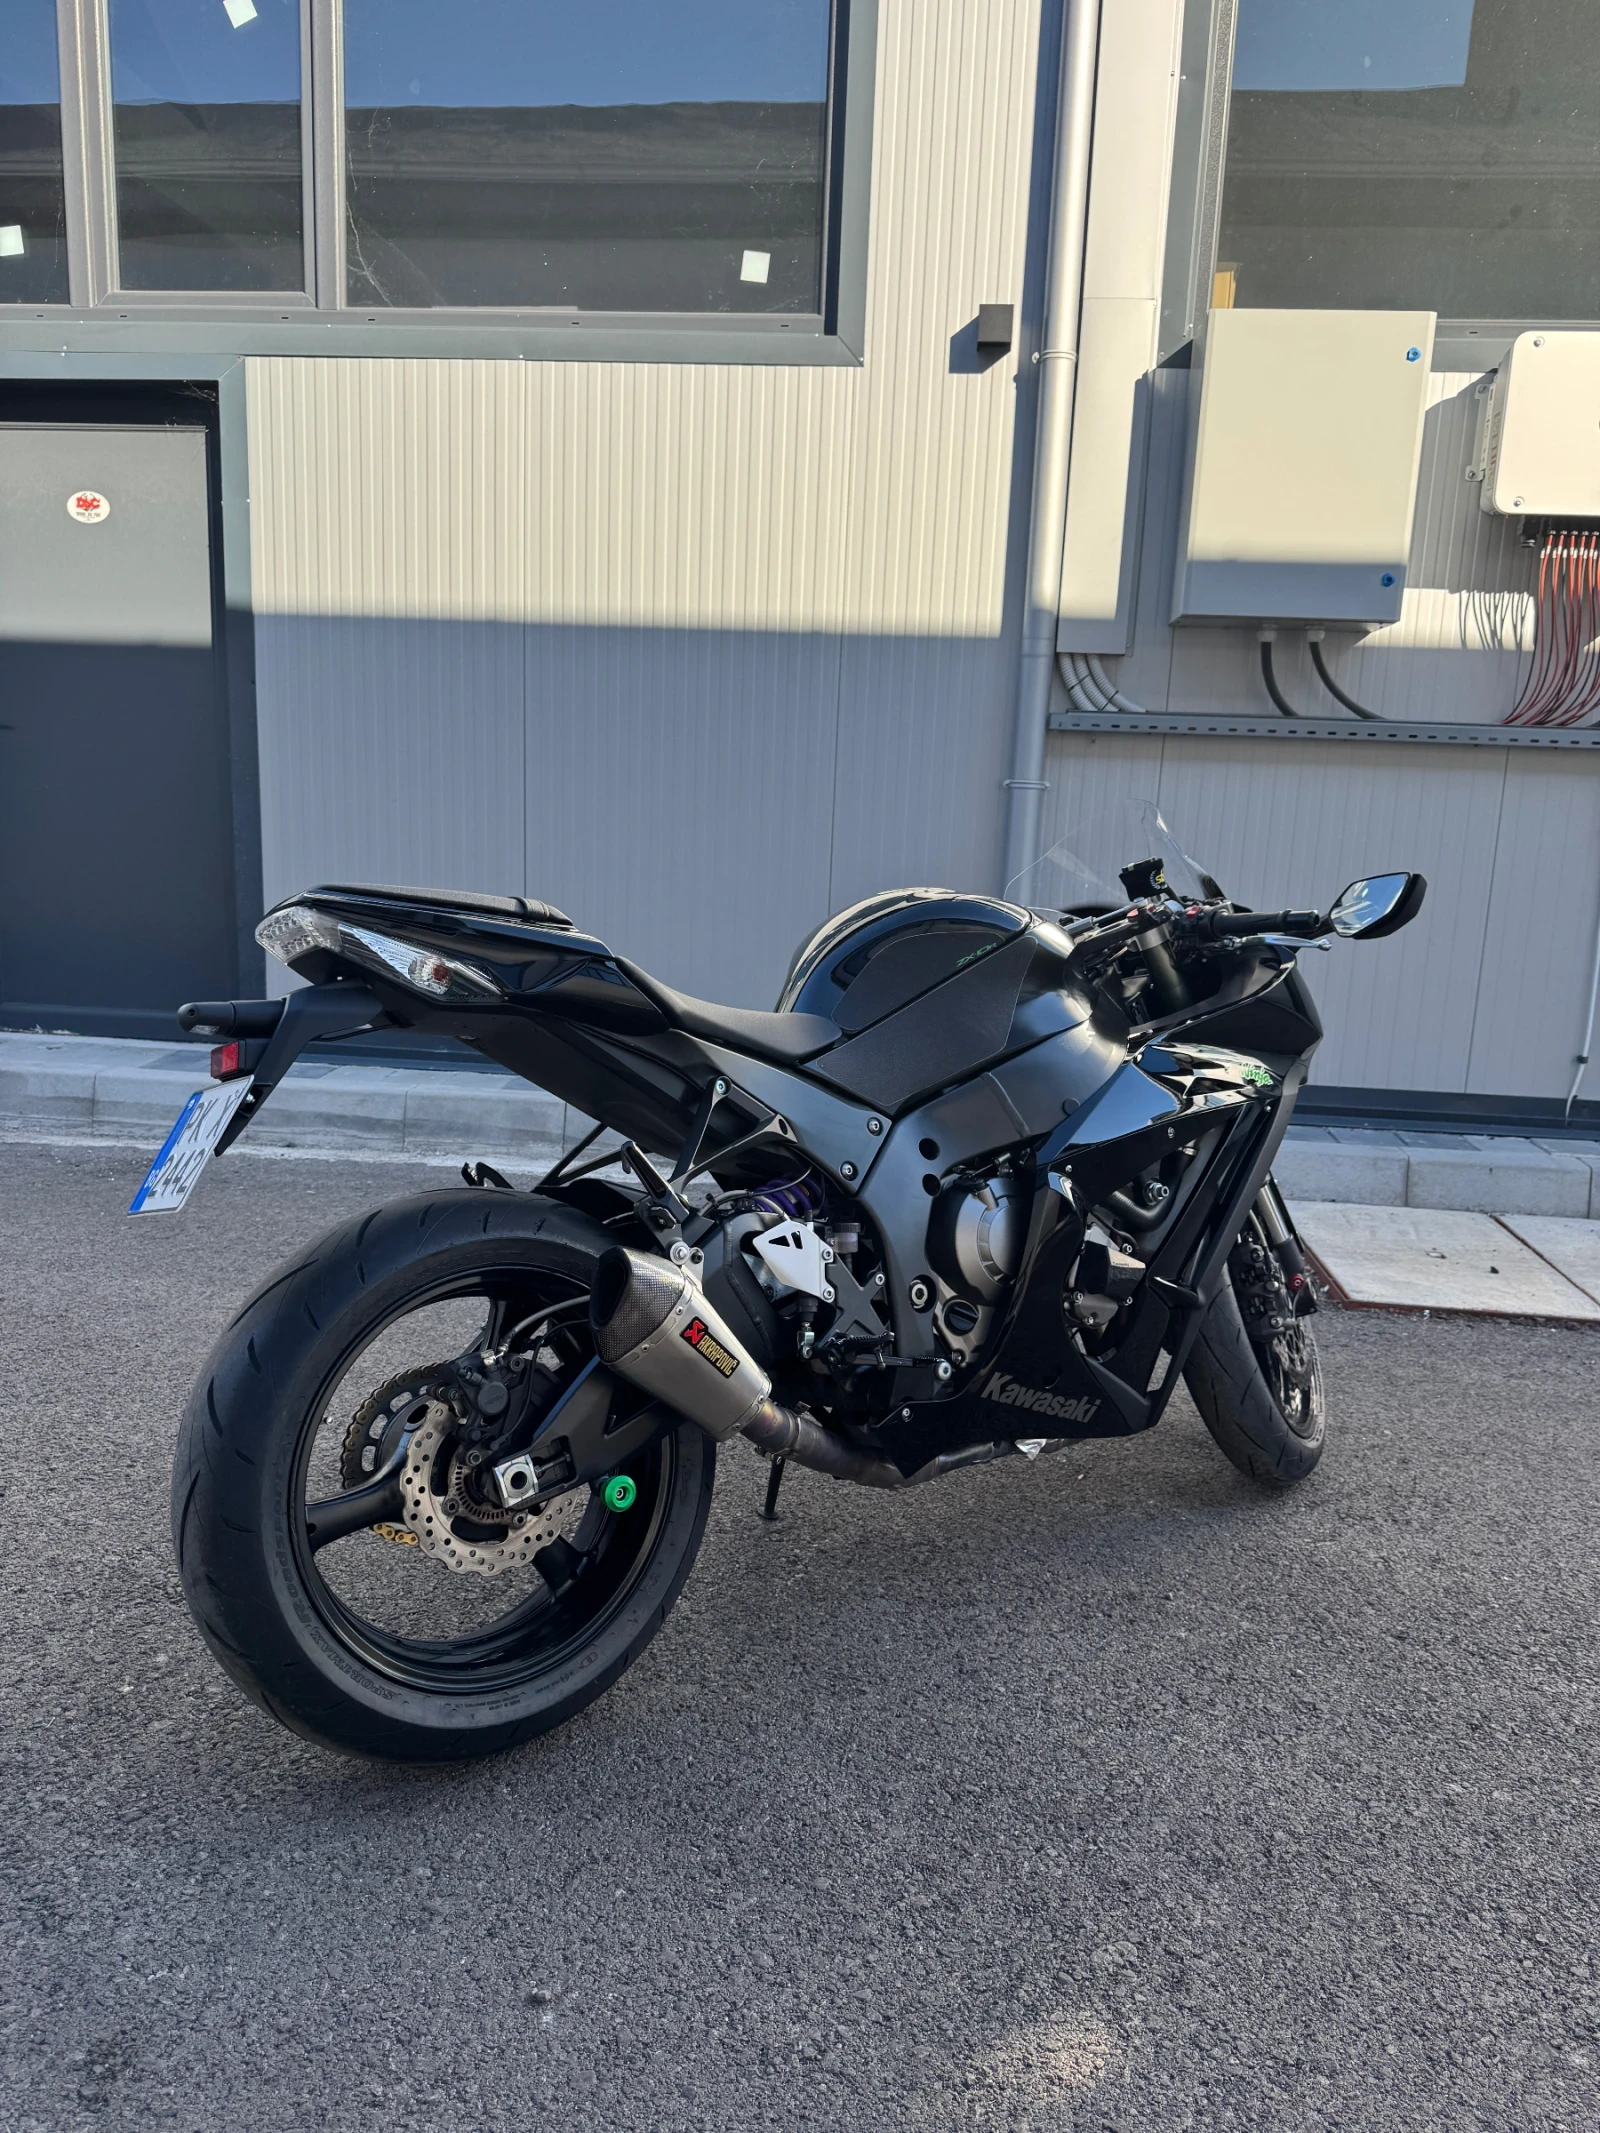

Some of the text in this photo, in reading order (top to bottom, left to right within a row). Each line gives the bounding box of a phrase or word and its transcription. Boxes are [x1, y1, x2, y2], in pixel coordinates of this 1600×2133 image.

[1241, 1063, 1274, 1087] Ninja
[177, 1098, 219, 1145] PK
[148, 1148, 208, 1198] 2442
[980, 1371, 1101, 1423] Kawasaki
